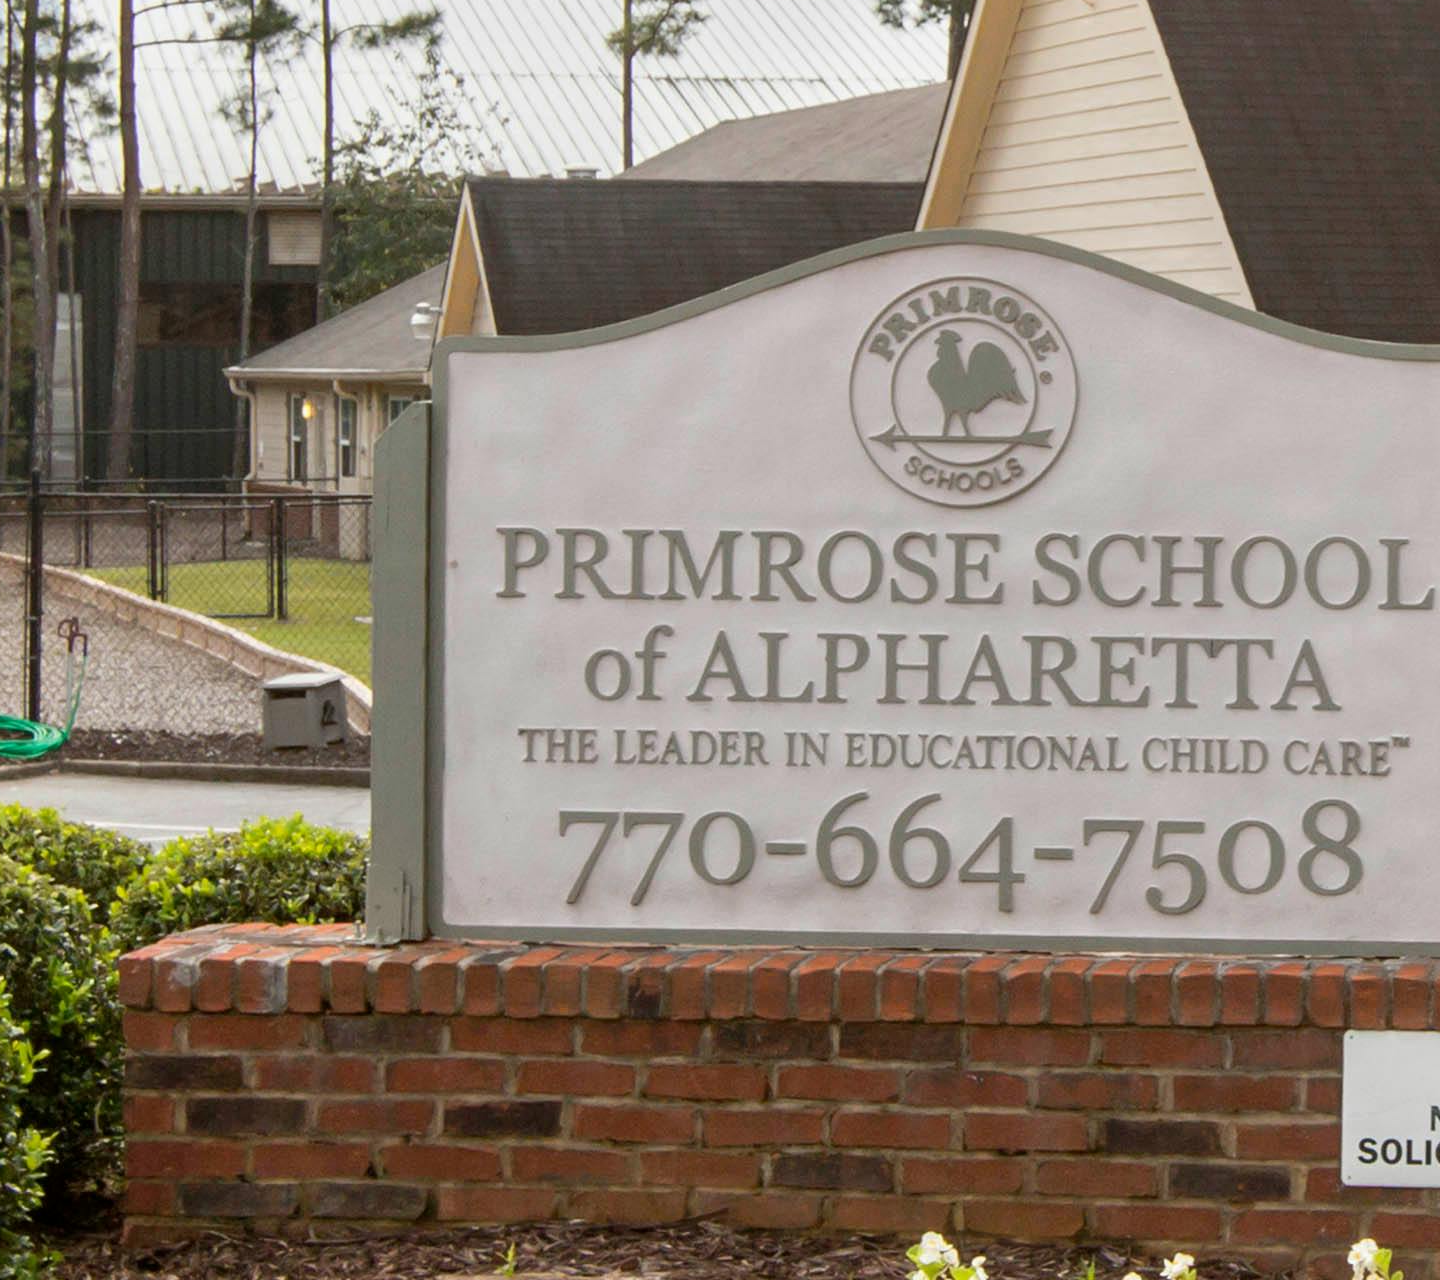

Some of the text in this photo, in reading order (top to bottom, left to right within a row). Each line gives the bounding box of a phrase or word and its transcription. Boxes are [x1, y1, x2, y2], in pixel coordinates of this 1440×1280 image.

[867, 285, 1060, 363] PRIMROSE
[903, 455, 1025, 493] SCHOOLS
[495, 526, 1436, 611] PRIMROSE SCHOOL
[583, 624, 1343, 712] of ALPHARETTA
[517, 727, 600, 763] THE
[613, 729, 769, 767] LEADER
[784, 731, 828, 768] IN
[845, 732, 1129, 772] EDUCATIONAL
[1141, 737, 1269, 774] CHILD
[558, 791, 1366, 916] 770-664-7508
